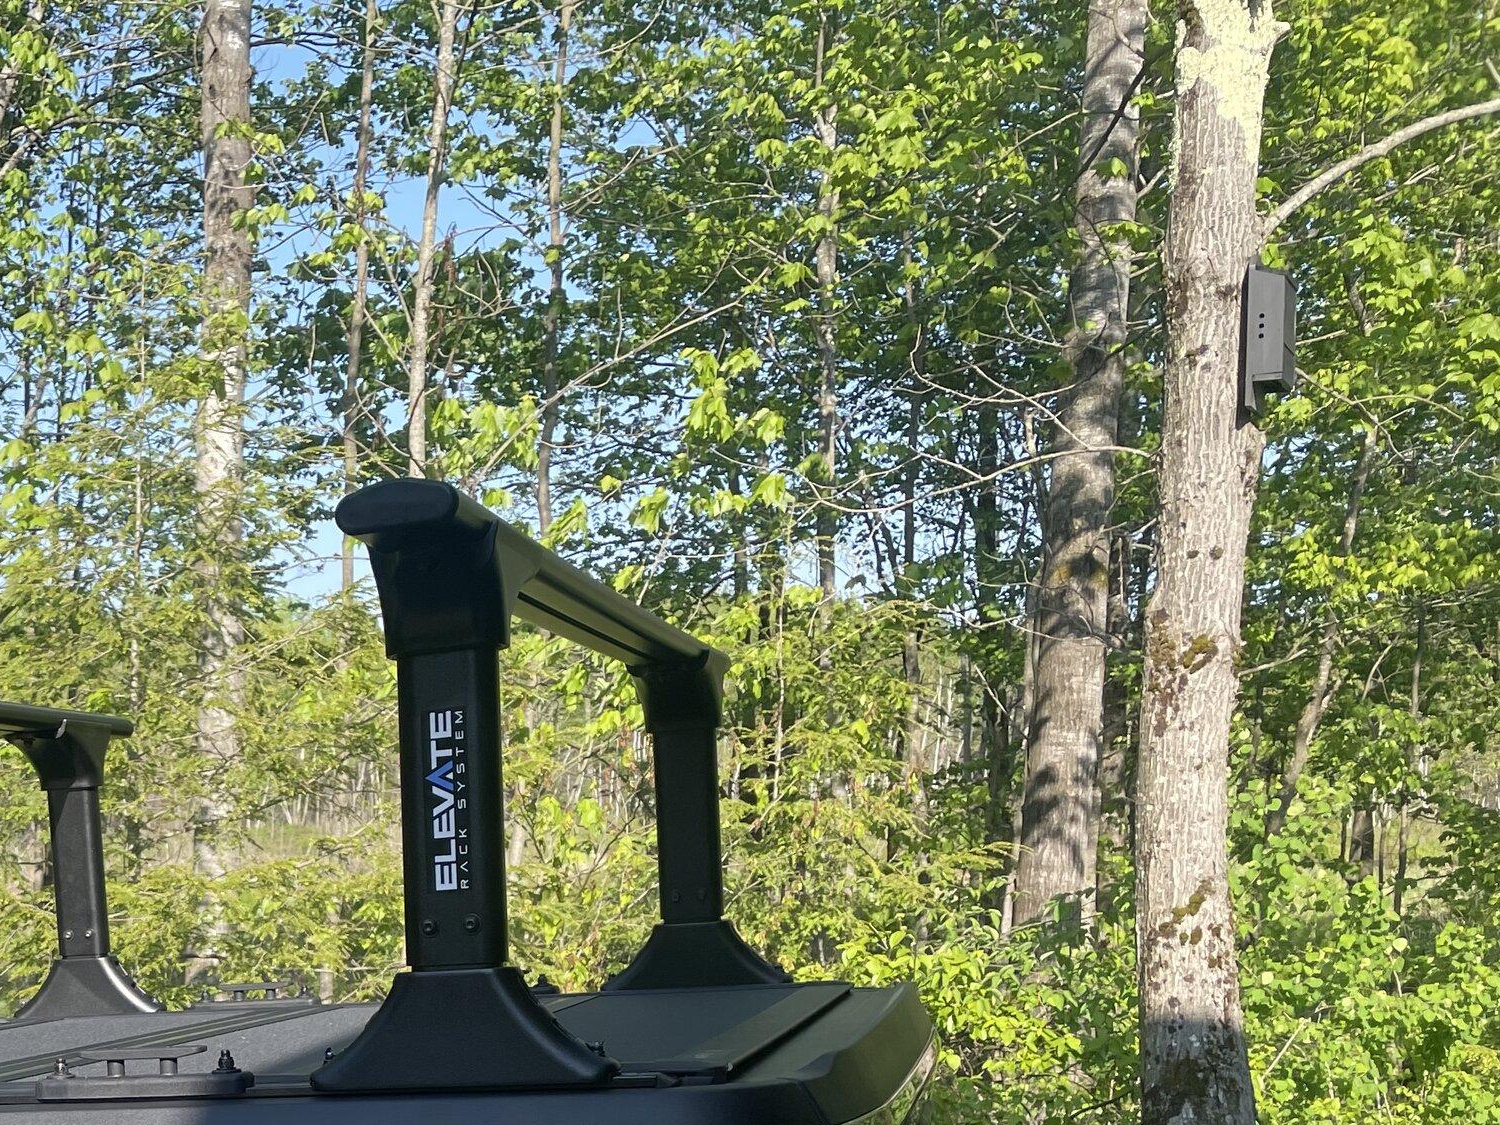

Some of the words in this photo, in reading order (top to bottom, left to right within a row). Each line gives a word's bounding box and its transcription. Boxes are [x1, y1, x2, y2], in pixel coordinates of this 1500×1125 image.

[424, 710, 457, 891] ELEVATE
[455, 710, 467, 809] SYSTEM
[460, 829, 471, 890] RACK
